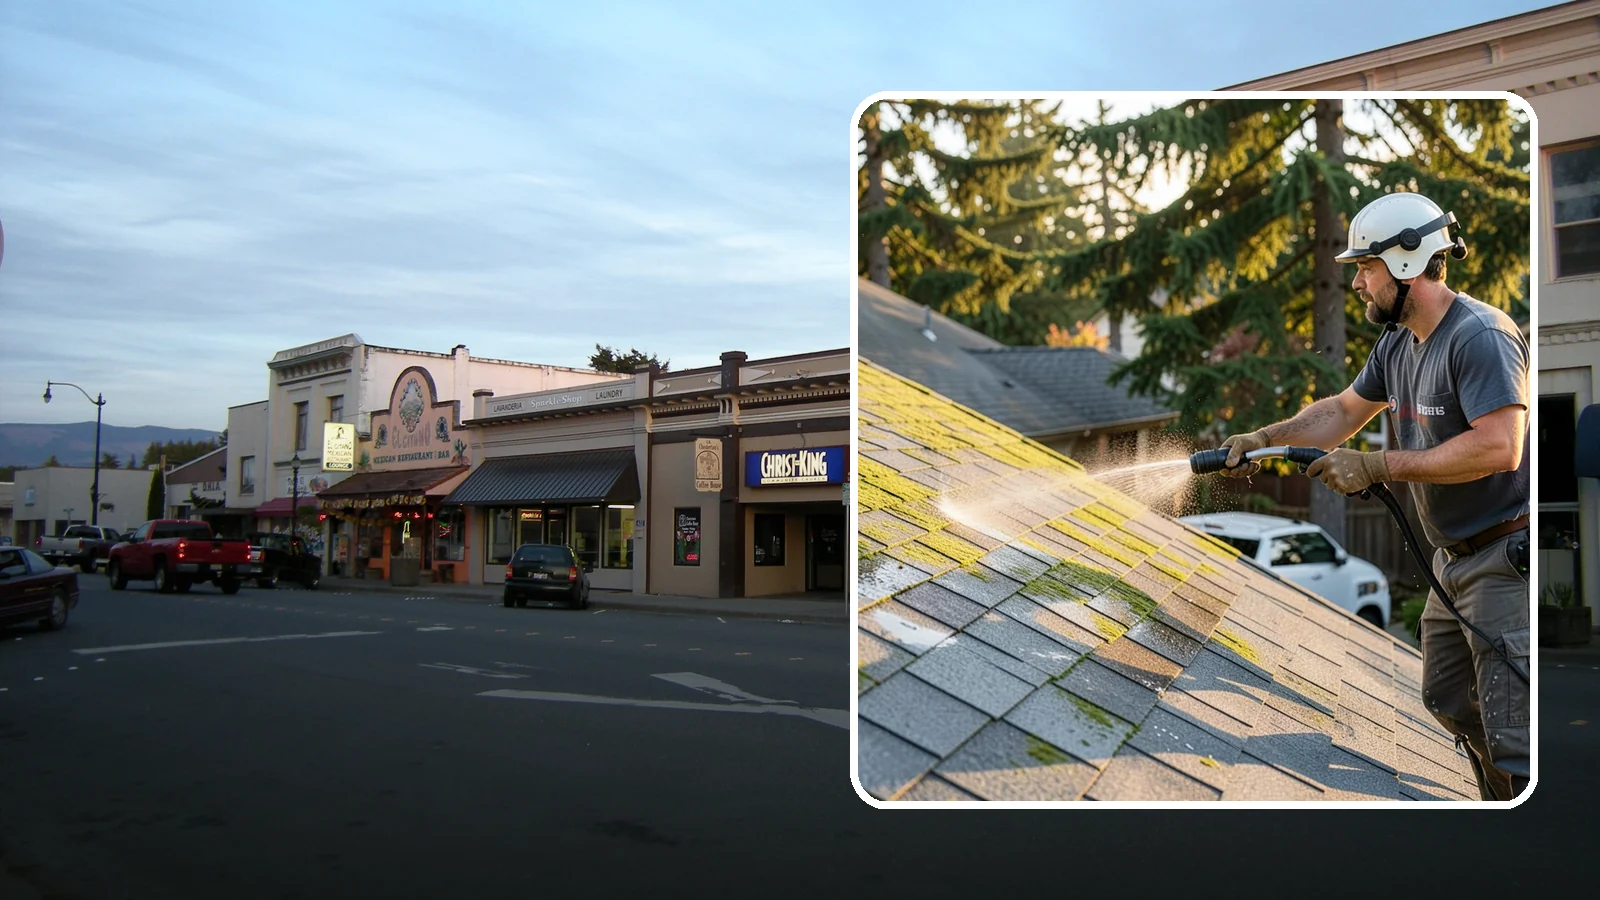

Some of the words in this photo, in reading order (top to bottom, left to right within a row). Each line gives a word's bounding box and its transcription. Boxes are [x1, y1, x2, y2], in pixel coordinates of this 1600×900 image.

[494, 402, 522, 412] LAVANDERIA
[562, 394, 582, 404] Shop
[596, 389, 624, 400] LAUNDRY
[373, 454, 396, 464] MEXICAN
[398, 451, 433, 462] RESTAURANT
[438, 450, 450, 459] BAR
